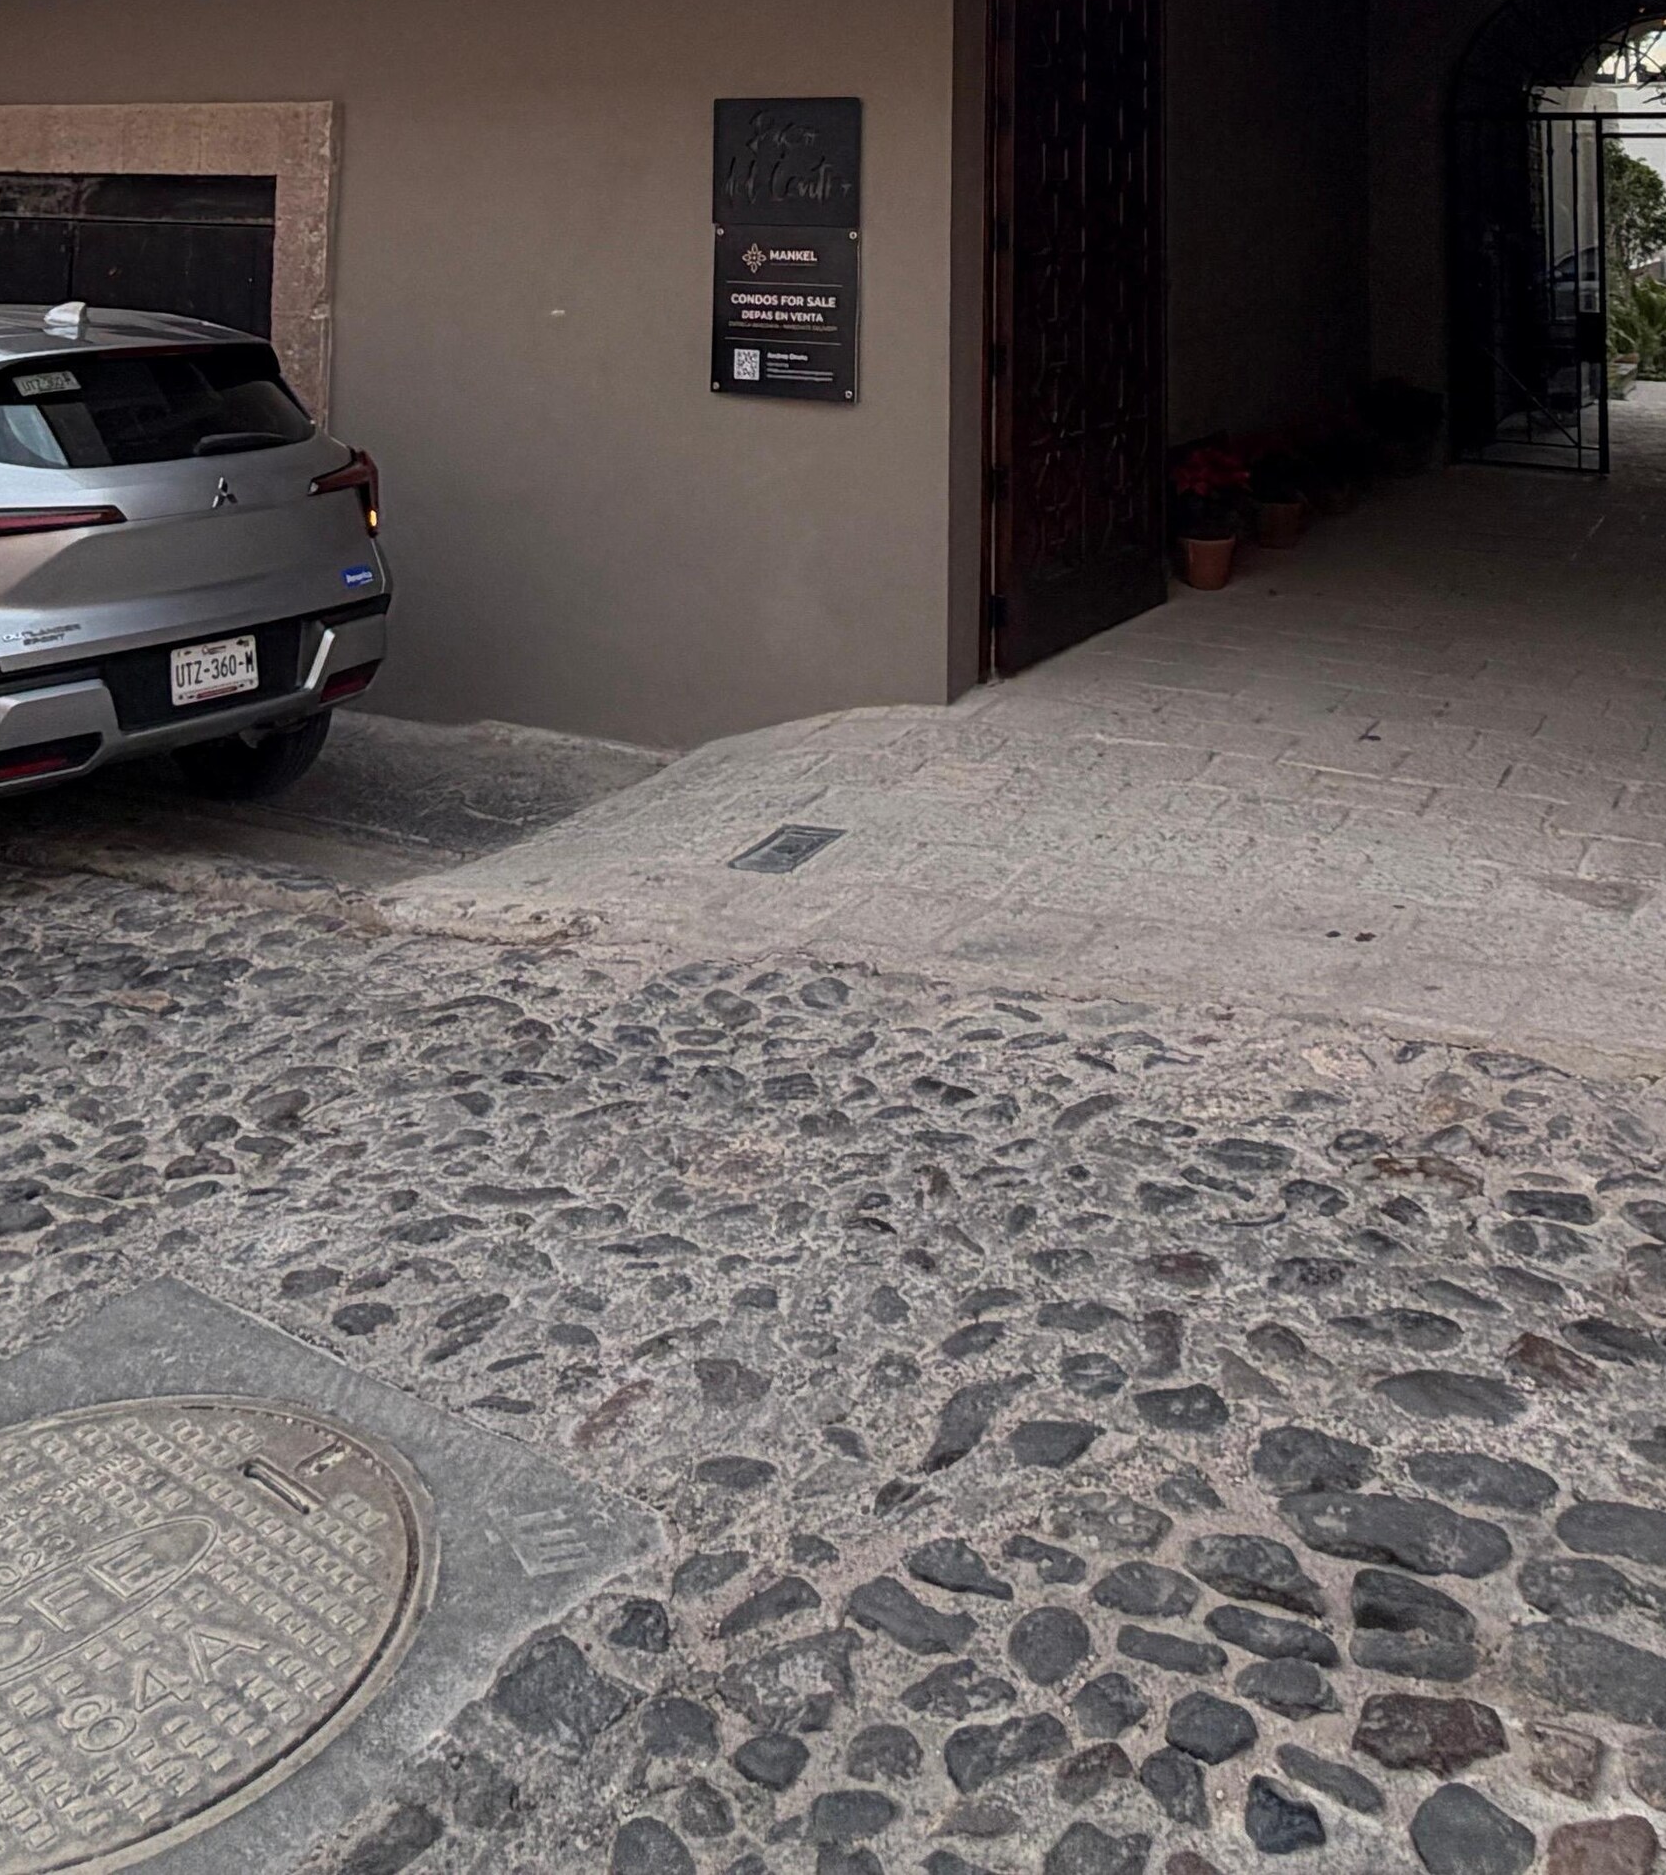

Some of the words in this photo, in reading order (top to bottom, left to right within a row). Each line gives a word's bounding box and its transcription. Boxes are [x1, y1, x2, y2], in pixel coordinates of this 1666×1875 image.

[770, 249, 818, 263] MANKEL
[730, 293, 779, 305] CONDOS
[780, 294, 804, 307] FOR
[806, 296, 837, 308] SALE
[741, 309, 773, 321] DEPAS
[774, 311, 789, 322] EN
[790, 312, 824, 323] VENTA
[175, 649, 255, 688] UTZ-360-M
[58, 1623, 271, 1753] 84A
